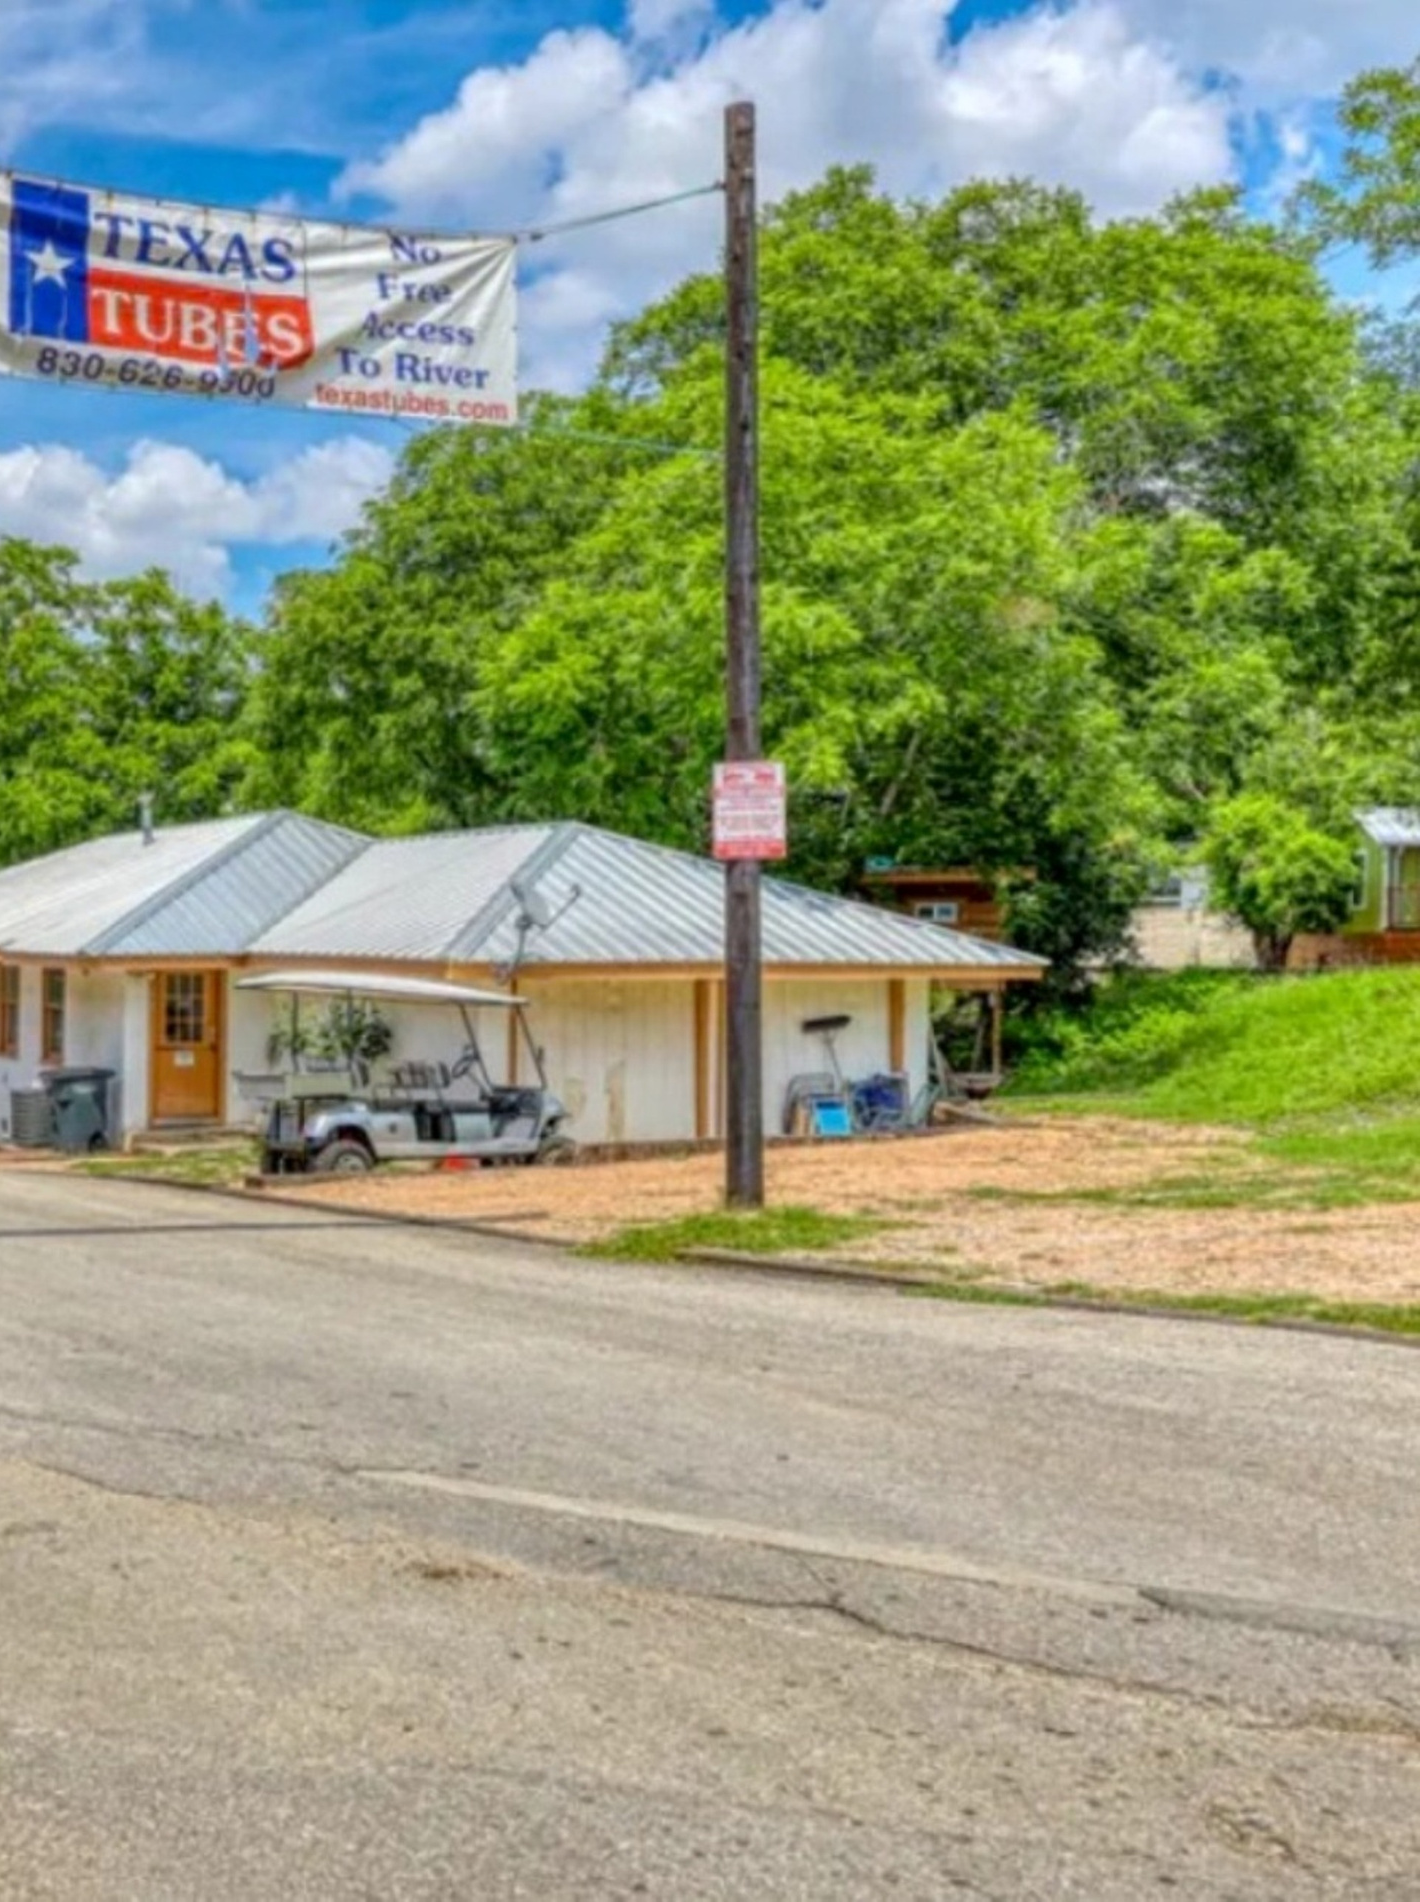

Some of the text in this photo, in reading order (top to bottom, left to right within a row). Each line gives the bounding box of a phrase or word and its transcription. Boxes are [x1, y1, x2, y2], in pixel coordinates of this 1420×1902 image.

[94, 212, 297, 283] TEXAS
[389, 233, 442, 265] No
[377, 272, 452, 303] Free
[91, 286, 305, 360] TUBES
[362, 311, 475, 346] Access
[336, 347, 490, 390] To River
[315, 382, 510, 420] texastubes.com
